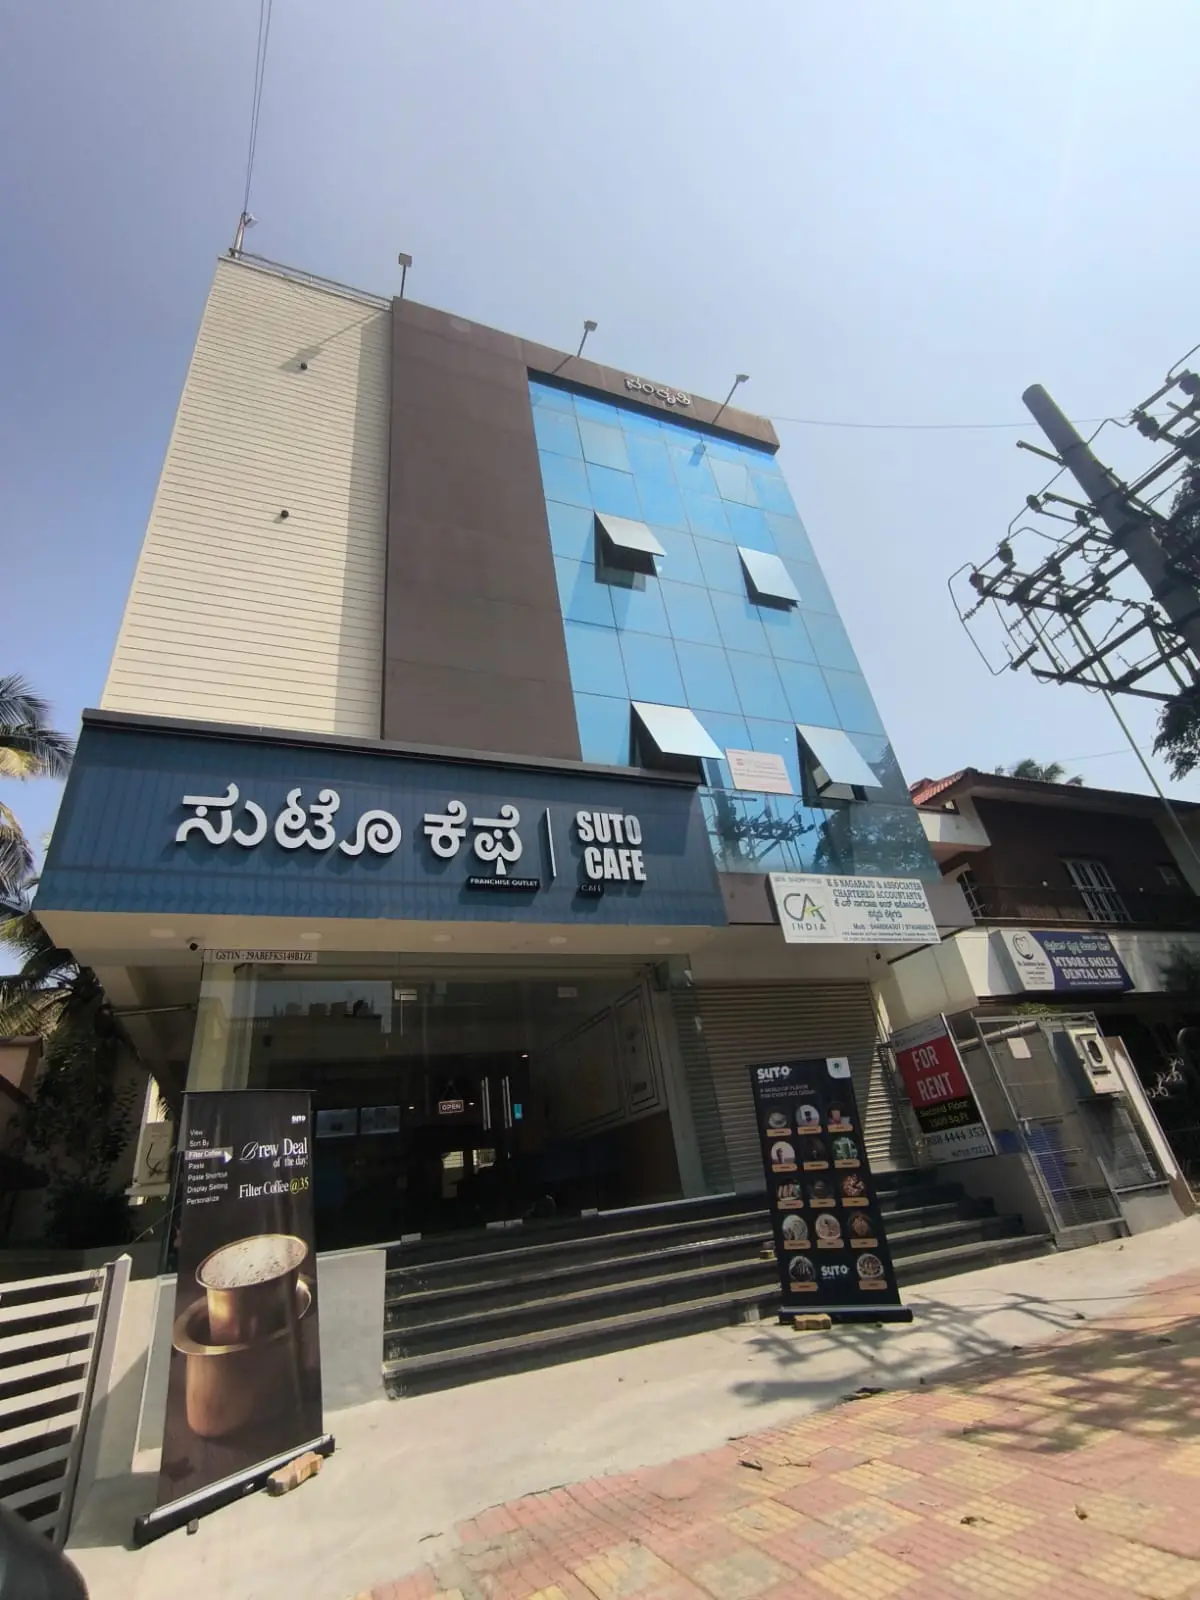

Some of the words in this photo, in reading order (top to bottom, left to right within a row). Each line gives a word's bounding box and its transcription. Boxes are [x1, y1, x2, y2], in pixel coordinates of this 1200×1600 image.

[576, 810, 643, 845] SUTO
[423, 800, 523, 875] ಕೆಫೆ
[584, 847, 647, 881] CAFE
[470, 878, 510, 886] FRANCHISE
[511, 879, 539, 887] OUTLET
[883, 881, 922, 890] ASSOCIATES
[832, 888, 875, 899] CHARTERED
[876, 890, 922, 900] ACCOUNTANTS
[791, 923, 826, 931] INDIA
[215, 951, 240, 960] GSTIN
[1052, 956, 1087, 967] MYSORE
[1087, 956, 1118, 967] SMILES
[1061, 968, 1096, 979] DENTAL
[1096, 968, 1121, 979] CARE
[911, 1045, 939, 1072] FOR
[757, 1066, 792, 1079] SUTO
[917, 1072, 953, 1100] RENT
[441, 1103, 461, 1111] OPEN
[189, 1139, 201, 1147] Sort
[202, 1139, 209, 1147] By
[239, 1141, 279, 1161] Brew
[283, 1137, 308, 1156] Deal
[273, 1157, 282, 1168] of
[284, 1157, 294, 1167] the
[188, 1173, 204, 1181] Paste
[205, 1171, 228, 1180] Shortcut
[187, 1185, 207, 1194] Display
[208, 1182, 228, 1191] Setting
[239, 1183, 262, 1199] Filter
[263, 1180, 290, 1195] Coffee
[186, 1195, 220, 1205] Personalize
[821, 1265, 849, 1277] SUTO
